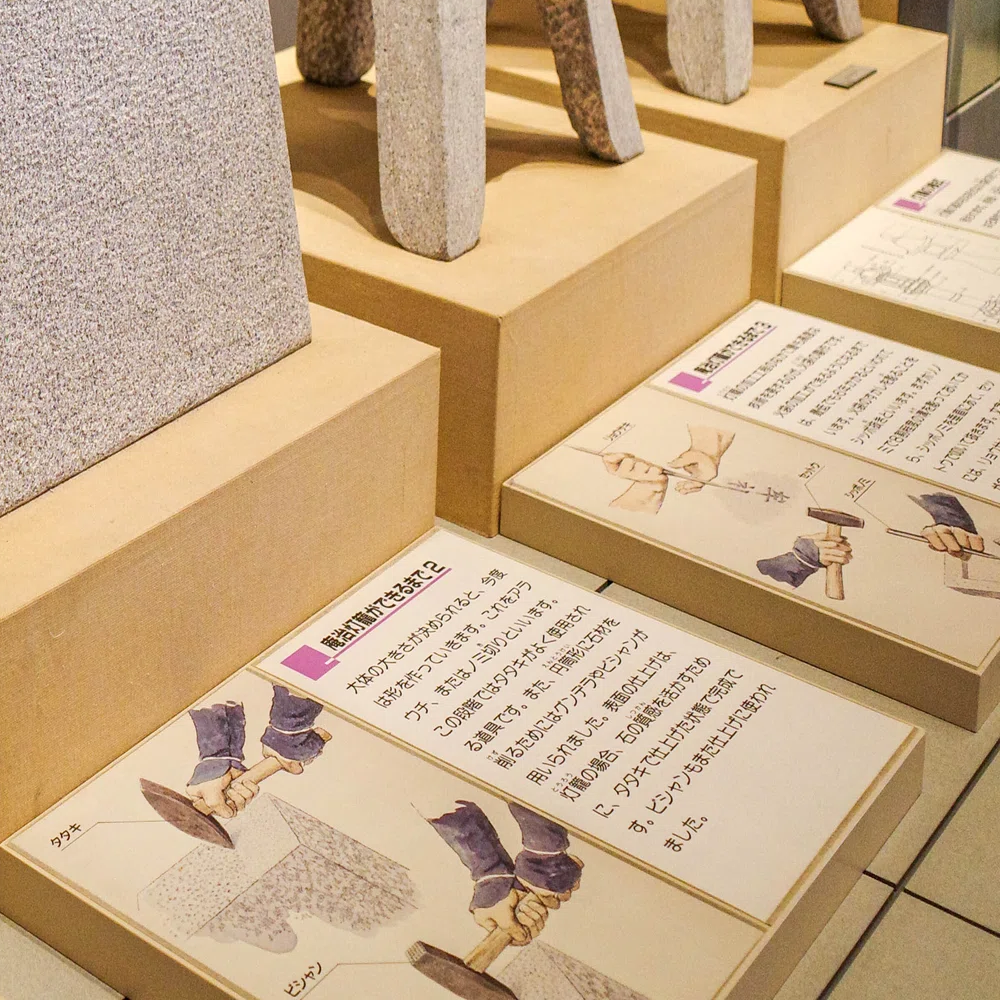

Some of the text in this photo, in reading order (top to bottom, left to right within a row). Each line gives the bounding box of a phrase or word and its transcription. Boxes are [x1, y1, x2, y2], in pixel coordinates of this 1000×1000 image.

[346, 569, 508, 694] 大体の大きさが決められると、今度
[373, 581, 531, 708] は形を作っていきます。これをアラ
[404, 599, 558, 721] ウチ、またはノミ切りといいます。
[434, 605, 591, 737] この段階ではタタキがよく使用され
[464, 618, 620, 751] る道具です。また、円筒形に石材を
[493, 629, 648, 770] 削るためにはグンデラやビシャンが
[526, 651, 676, 786] 用いられました。表面の仕上げは、
[592, 669, 743, 818] に、タタキで仕上げた状態で完成で
[628, 684, 776, 833] す。ビシャンもまた仕上げに使われ
[50, 823, 82, 848] タタキ
[664, 817, 708, 852] ました。
[283, 961, 322, 998] ビシャン
